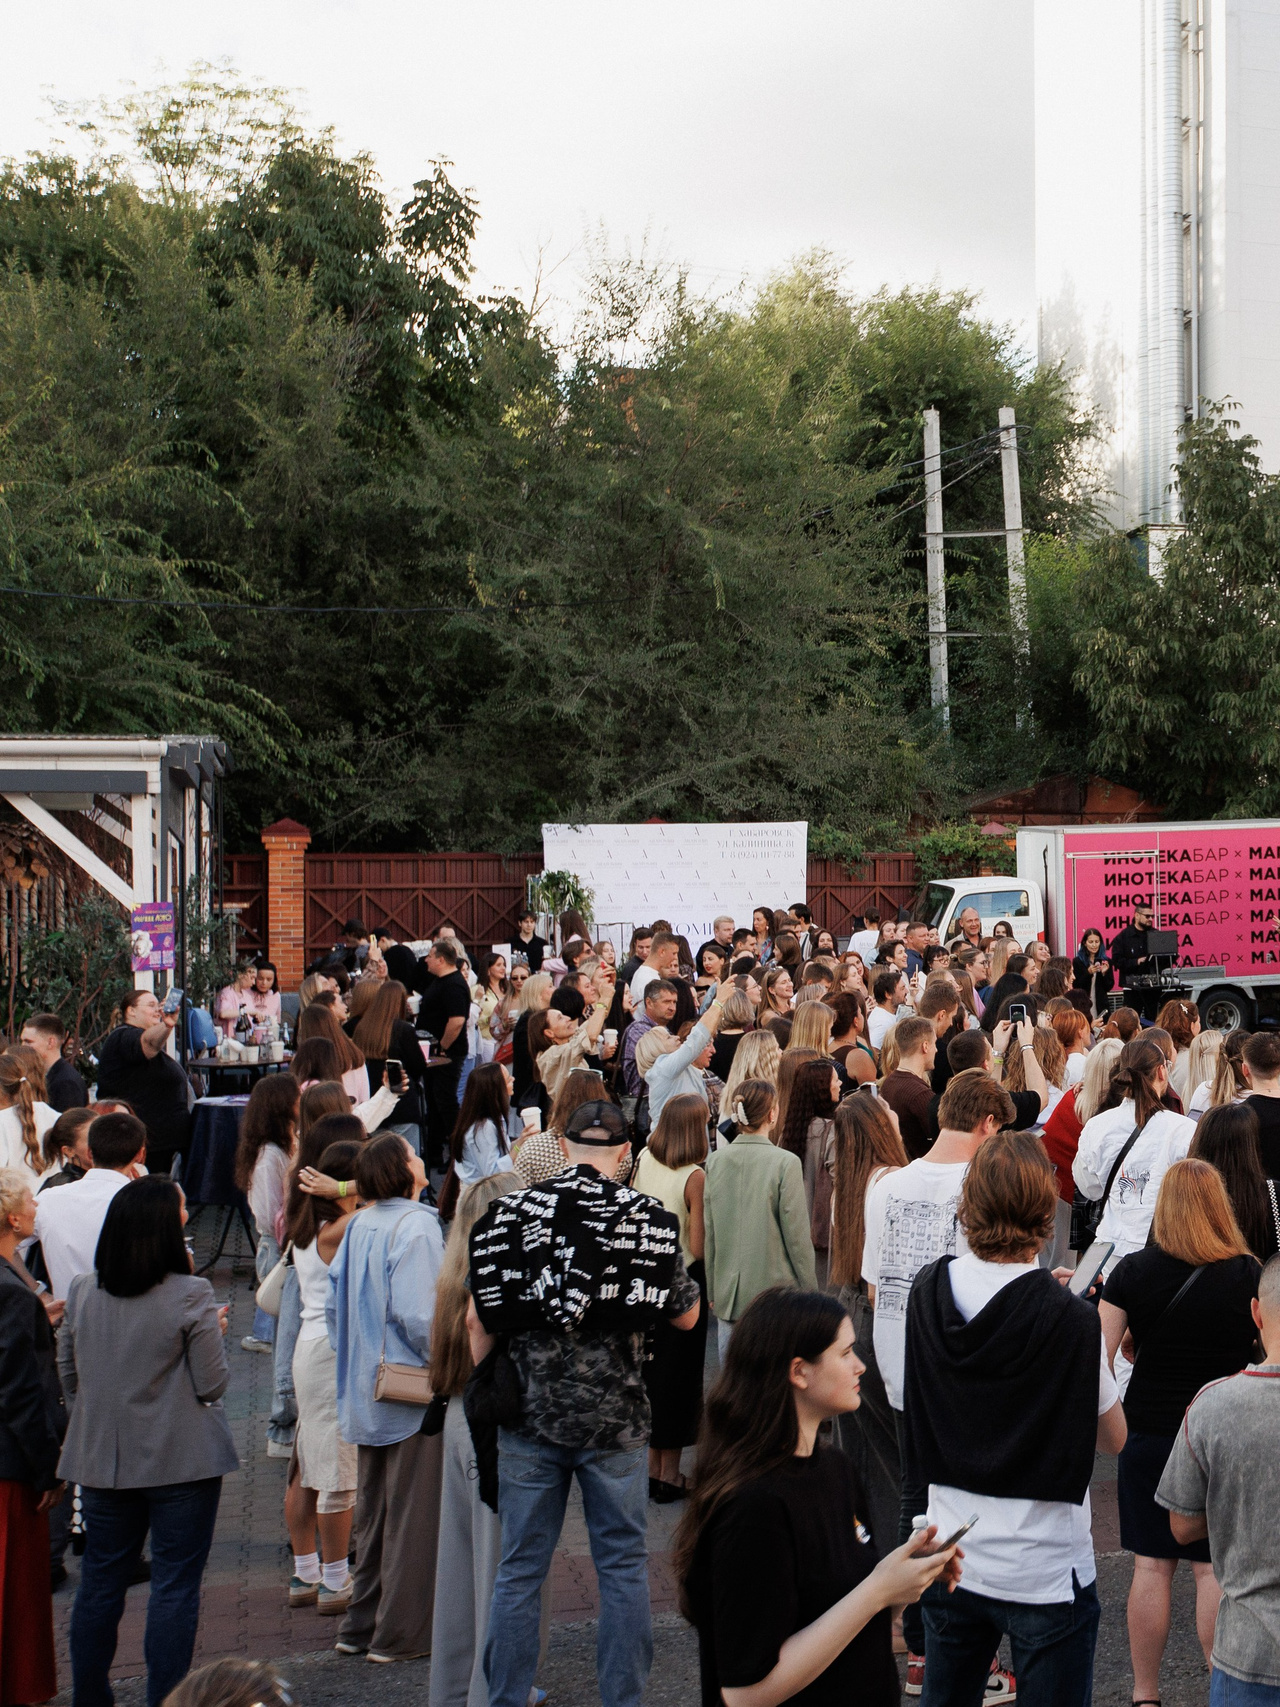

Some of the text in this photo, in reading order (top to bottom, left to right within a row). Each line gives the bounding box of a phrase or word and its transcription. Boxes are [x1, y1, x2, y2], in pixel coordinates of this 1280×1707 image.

[1104, 868, 1229, 887] ИНОТЕКАБАР
[1105, 889, 1230, 908] ИНОТЕКАБАР
[1105, 910, 1230, 929] ИНЕКАБАР
[614, 1221, 677, 1239] alm Angels
[613, 1237, 676, 1254] alm Angels
[477, 1263, 496, 1275] ngels
